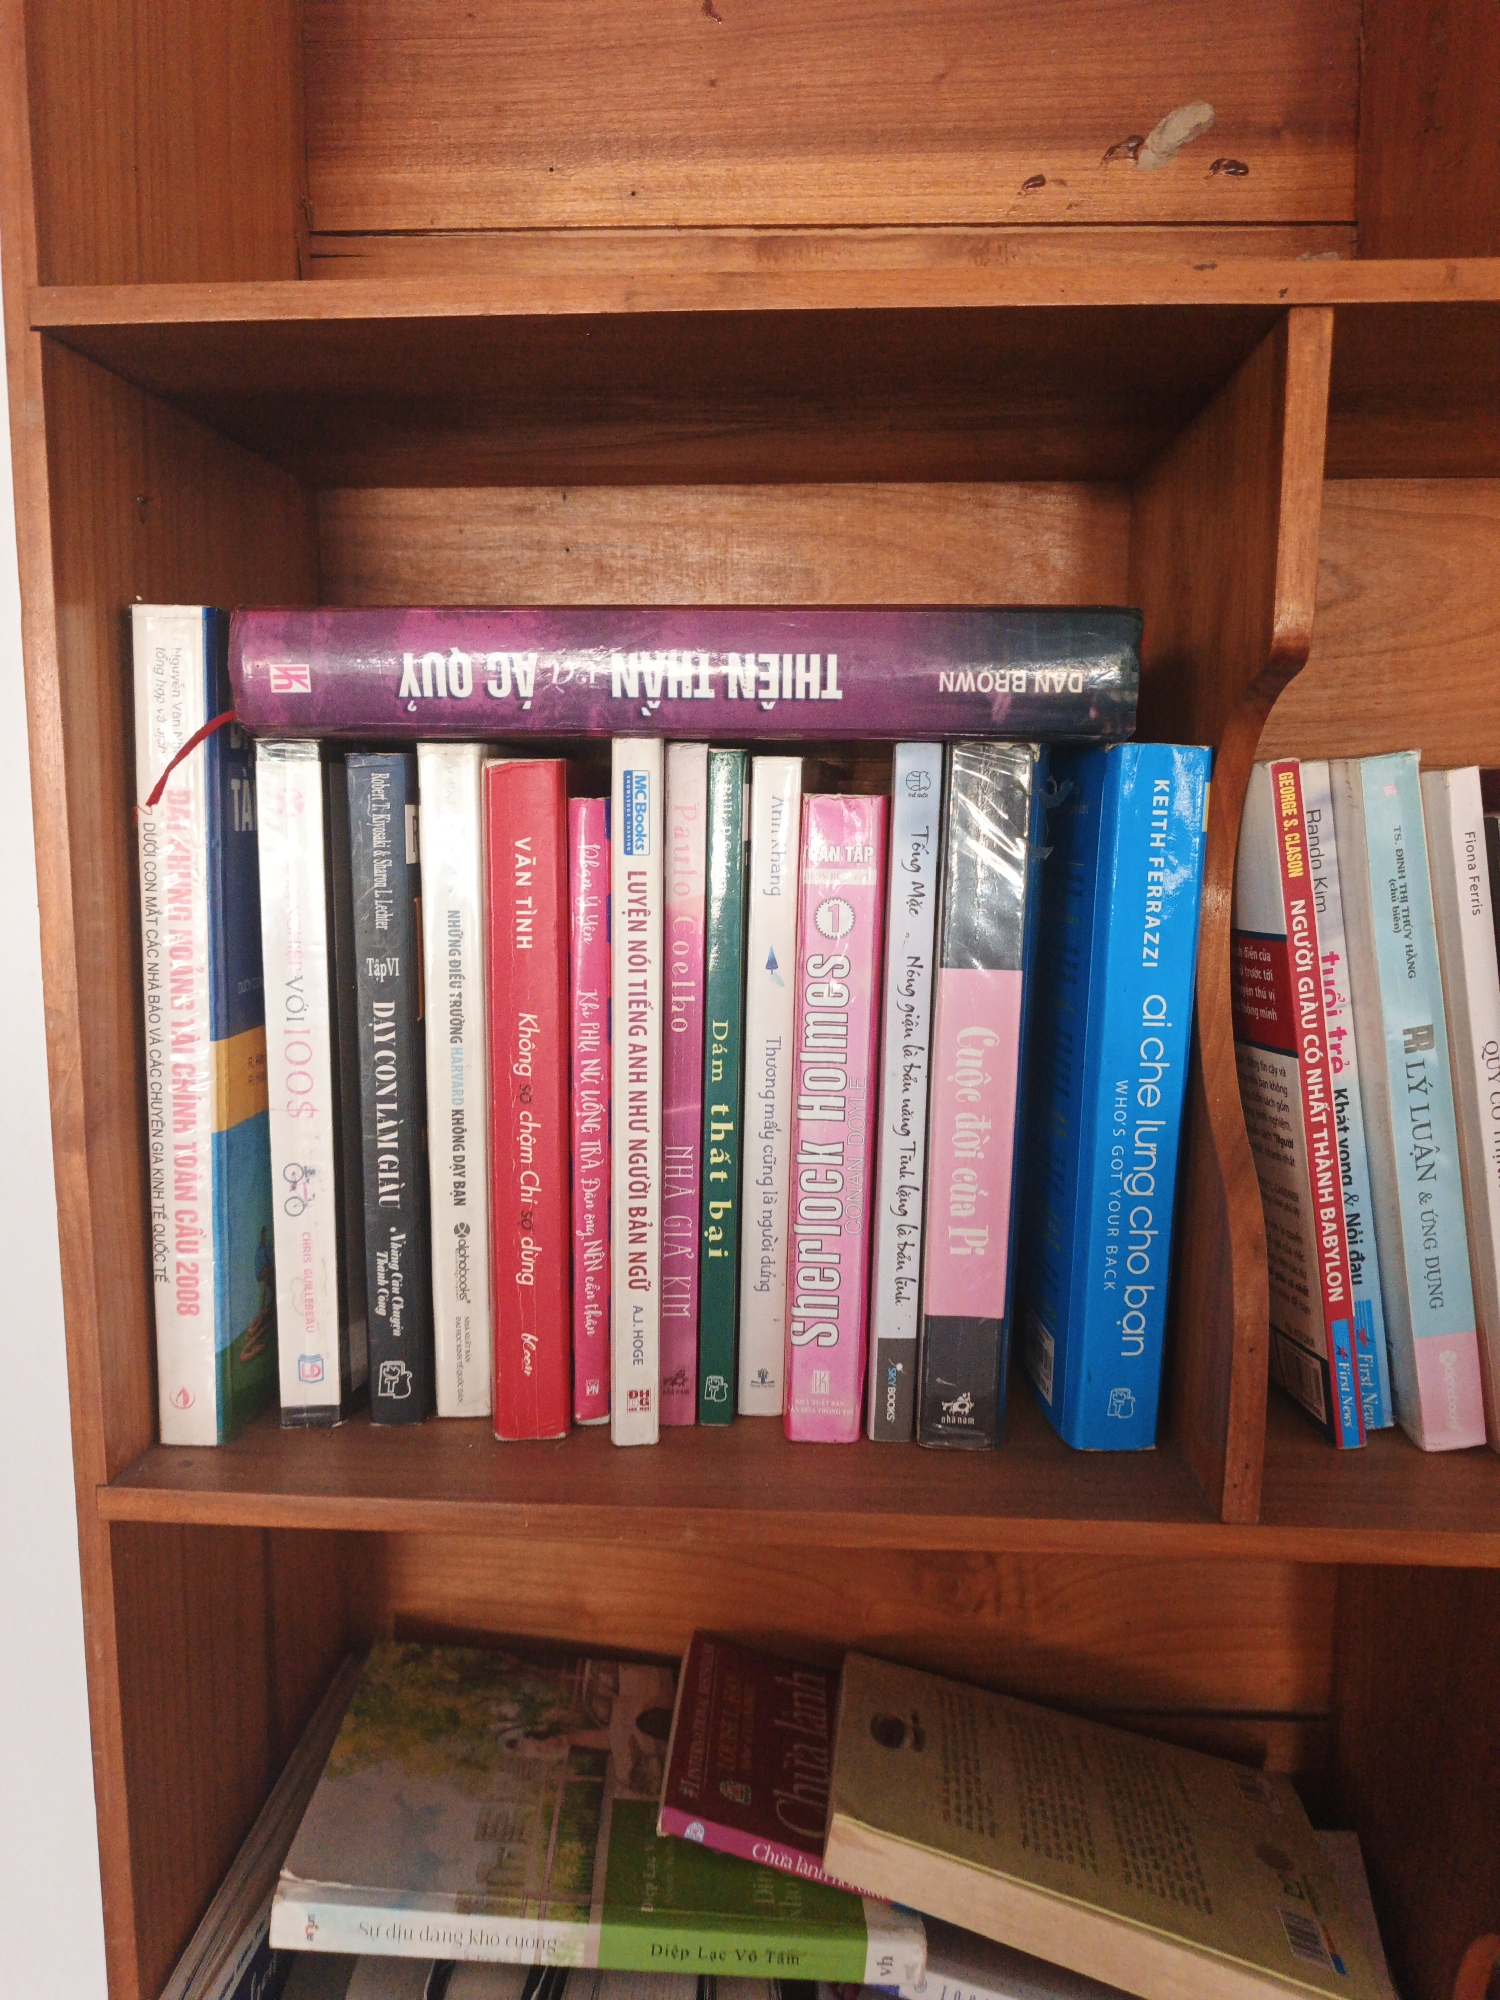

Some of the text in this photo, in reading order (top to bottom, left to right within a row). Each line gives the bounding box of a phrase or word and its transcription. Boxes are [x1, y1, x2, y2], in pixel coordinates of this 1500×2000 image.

[397, 645, 843, 717] THIÊN THẦN và ÁC QUỶ
[938, 669, 1085, 693] DAN BROWN
[371, 772, 393, 801] Robert
[366, 813, 394, 849] Kiyosaki
[1277, 771, 1304, 879] GEORGE S. CLASON
[1392, 824, 1404, 847] TS.
[372, 858, 394, 888] Sharon
[373, 850, 392, 858] &
[901, 824, 931, 918] Tống Mặc
[1141, 779, 1171, 969] KEITH FERRAZZI
[1305, 809, 1329, 914] Rando Kim
[1395, 848, 1407, 880] ĐINH
[1463, 830, 1484, 917] Fiona Ferris
[374, 899, 394, 930] Lechter
[1398, 881, 1410, 904] THỊ
[447, 909, 465, 957] NHỮNG
[669, 802, 699, 1034] Paulo Coelho
[827, 903, 841, 933] 1
[1391, 906, 1403, 935] biên)
[1400, 906, 1413, 940] THÚY
[449, 959, 466, 989] ĐIỀU
[449, 991, 466, 1045] TRƯỜNG
[578, 989, 600, 1019] Khi
[143, 822, 171, 1284] DƯỚI CON MẮT CÁC NHÀ BÁO VÀ CÁC CHUYÊN GIA KINH TẾ QUỐC TẾ
[578, 1022, 602, 1053] PHỤ
[450, 1046, 465, 1107] HARVARD
[579, 1058, 605, 1086] NỮ
[620, 869, 654, 1293] LUYỆN NÓI TIẾNG ANH NHƯ NGƯỜI BẢN NGỮ
[757, 1035, 782, 1100] Thương
[1404, 1058, 1434, 1097] LÝ
[368, 1000, 406, 1210] DẠY CON LÀM GIÀU
[576, 1090, 607, 1135] UỐNG
[757, 1103, 782, 1141] mấy
[1289, 898, 1345, 1303] NGƯỜI GIÀU CÓ NHẤT THÀNH BABYLON
[451, 1108, 469, 1153] KHÔNG
[704, 1019, 734, 1260] Dám thất bại
[790, 953, 851, 1348] Sherlock Holmes
[889, 955, 925, 1306] Nóng giận là bản năng Tĩnh lặng là bản lĩnh
[946, 1026, 1001, 1257] Cuộc đời của Pi
[1409, 1103, 1442, 1184] LUẬN
[449, 1154, 467, 1179] DẠY
[755, 1144, 778, 1187] cũng
[845, 1077, 867, 1236] CONAN DOYLE
[1115, 993, 1174, 1358] ai che lưng cho bạn
[449, 1180, 467, 1207] BẠN
[580, 1177, 602, 1211] Đàn
[760, 1191, 779, 1205] là
[1103, 1078, 1129, 1293] WHO'S GOT YOUR BACK
[1416, 1191, 1431, 1206] &
[575, 1213, 597, 1241] ông
[661, 1143, 696, 1319] NHÀ GIẢ KIM
[756, 1209, 779, 1253] người
[1419, 1209, 1441, 1252] ỨNG
[375, 1250, 391, 1287] Thành
[583, 1239, 607, 1273] NÊN
[301, 1231, 316, 1334] CHRIS GUILLEBEAU
[584, 1275, 601, 1301] cẩn
[1425, 1254, 1446, 1311] DỤNG
[584, 1303, 604, 1338] thận
[632, 1304, 645, 1367] A.J. HOGE
[1338, 1362, 1354, 1428] First News
[1358, 1353, 1379, 1432] First News
[650, 1943, 691, 1963] Diệp
[698, 1946, 727, 1963] Lạc
